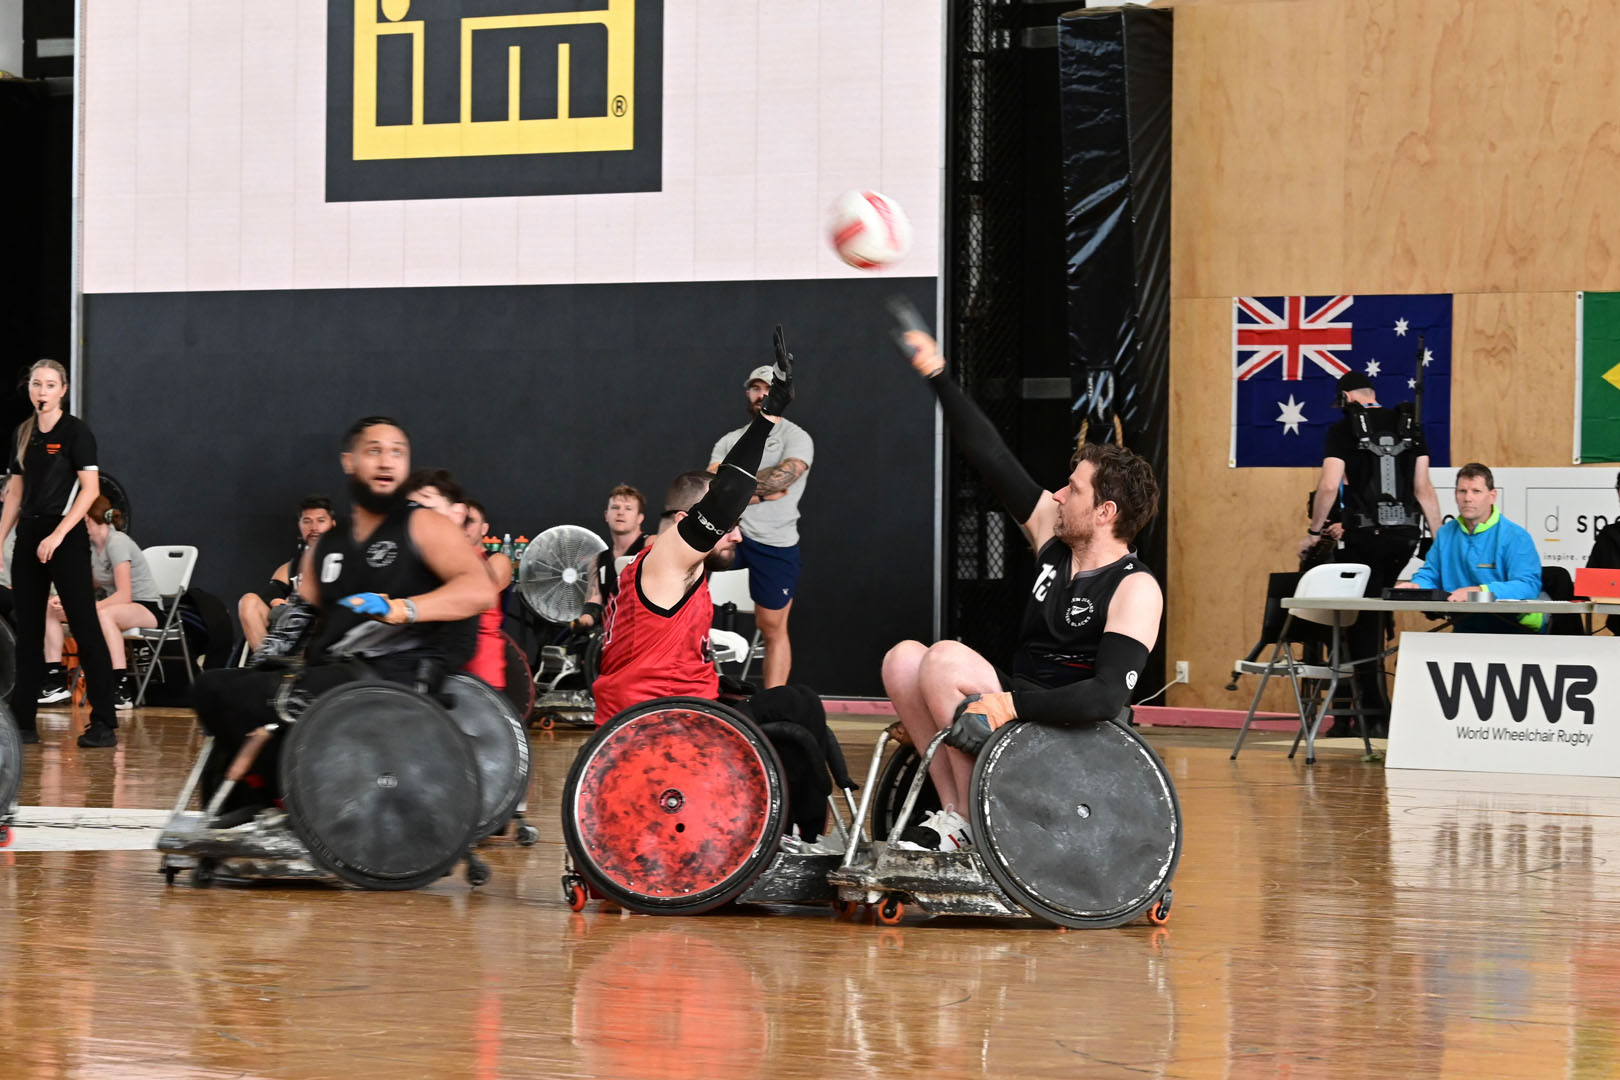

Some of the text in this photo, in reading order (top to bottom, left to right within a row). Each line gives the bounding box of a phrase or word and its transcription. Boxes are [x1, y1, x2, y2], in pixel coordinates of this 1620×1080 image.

[321, 553, 344, 583] 6
[1426, 661, 1598, 725] WWR
[1456, 726, 1593, 747] World Wheelchair Rugby
